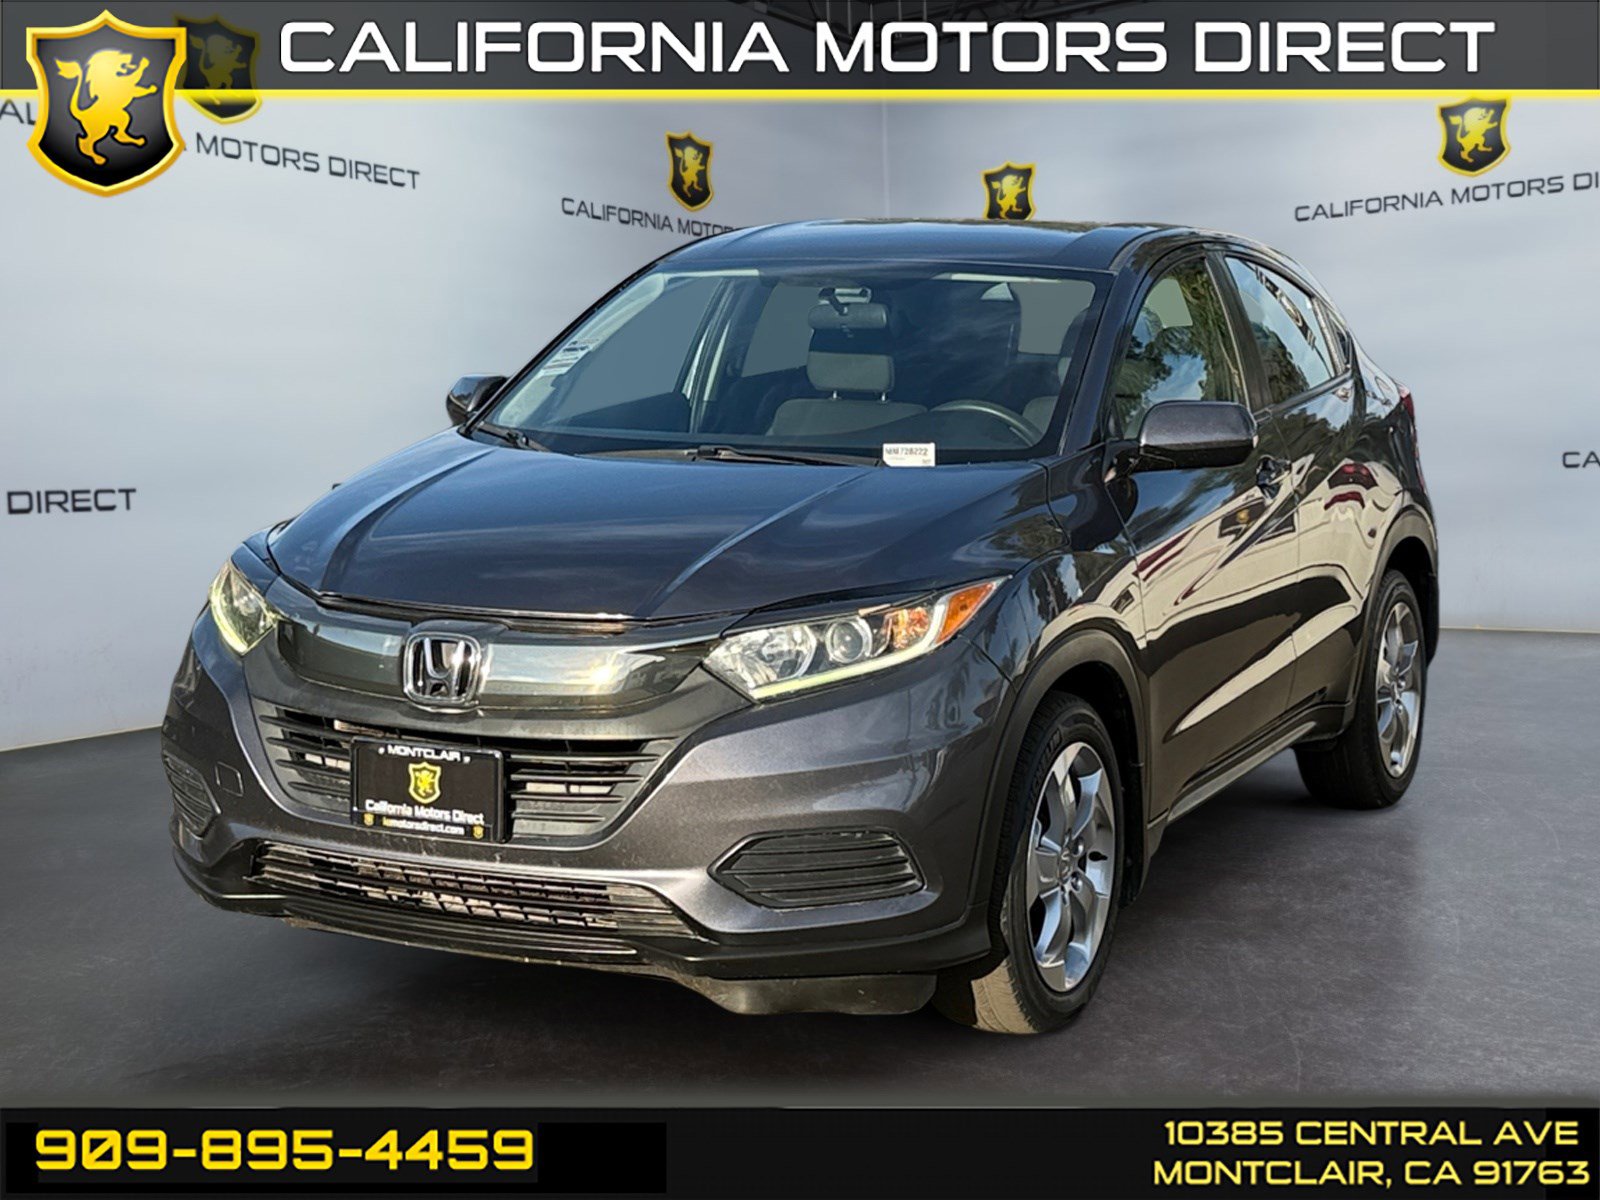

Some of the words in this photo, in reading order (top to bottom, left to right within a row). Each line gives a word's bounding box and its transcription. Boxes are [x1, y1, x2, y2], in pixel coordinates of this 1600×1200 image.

[196, 132, 320, 173] MOTORS
[328, 156, 420, 189] DIRECT
[1294, 190, 1443, 222] CALIFORNIA
[1450, 175, 1565, 205] MOTORS
[561, 197, 674, 232] CALIFORNIA
[7, 488, 137, 515] DIRECT
[387, 745, 461, 762] MONTCLAIR
[365, 799, 413, 816] California
[414, 805, 451, 820] Motors
[452, 809, 485, 824] Direct
